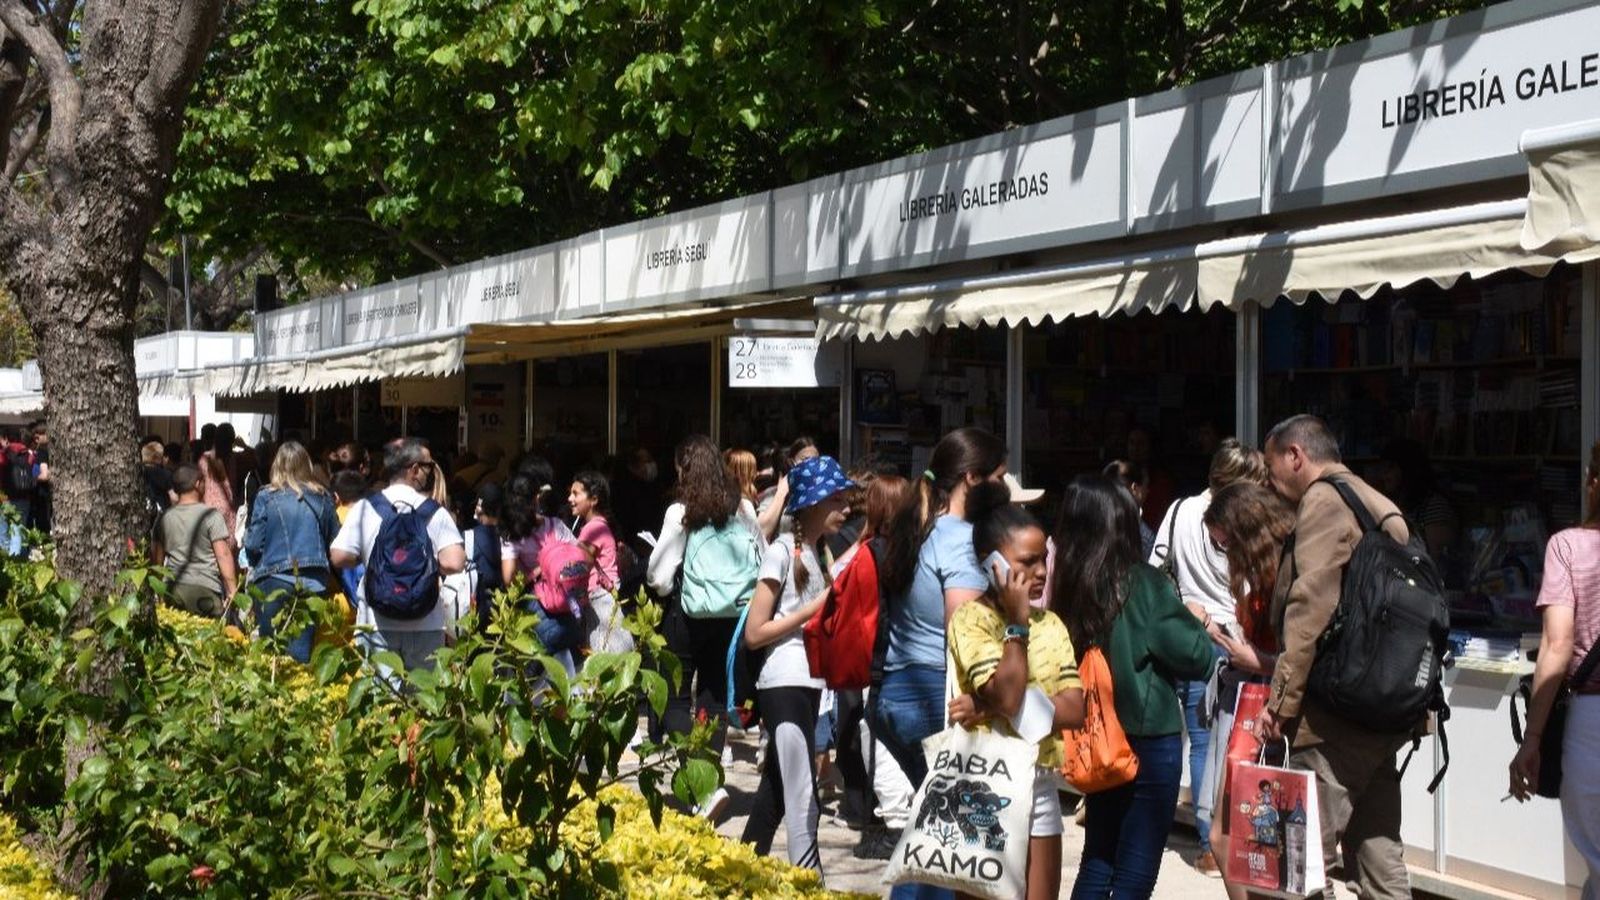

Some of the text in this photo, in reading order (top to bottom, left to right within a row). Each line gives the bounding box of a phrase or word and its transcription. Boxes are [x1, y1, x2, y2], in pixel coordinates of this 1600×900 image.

[1381, 52, 1599, 129] LIBRERÍA GALE
[899, 171, 1049, 222] LIBRERÍA GALERADAS
[646, 243, 684, 270] LIBRERÍA
[735, 337, 757, 357] 27
[735, 362, 757, 379] 28
[385, 389, 400, 401] 30
[934, 750, 1012, 782] BABA
[903, 843, 1003, 881] KAMO
